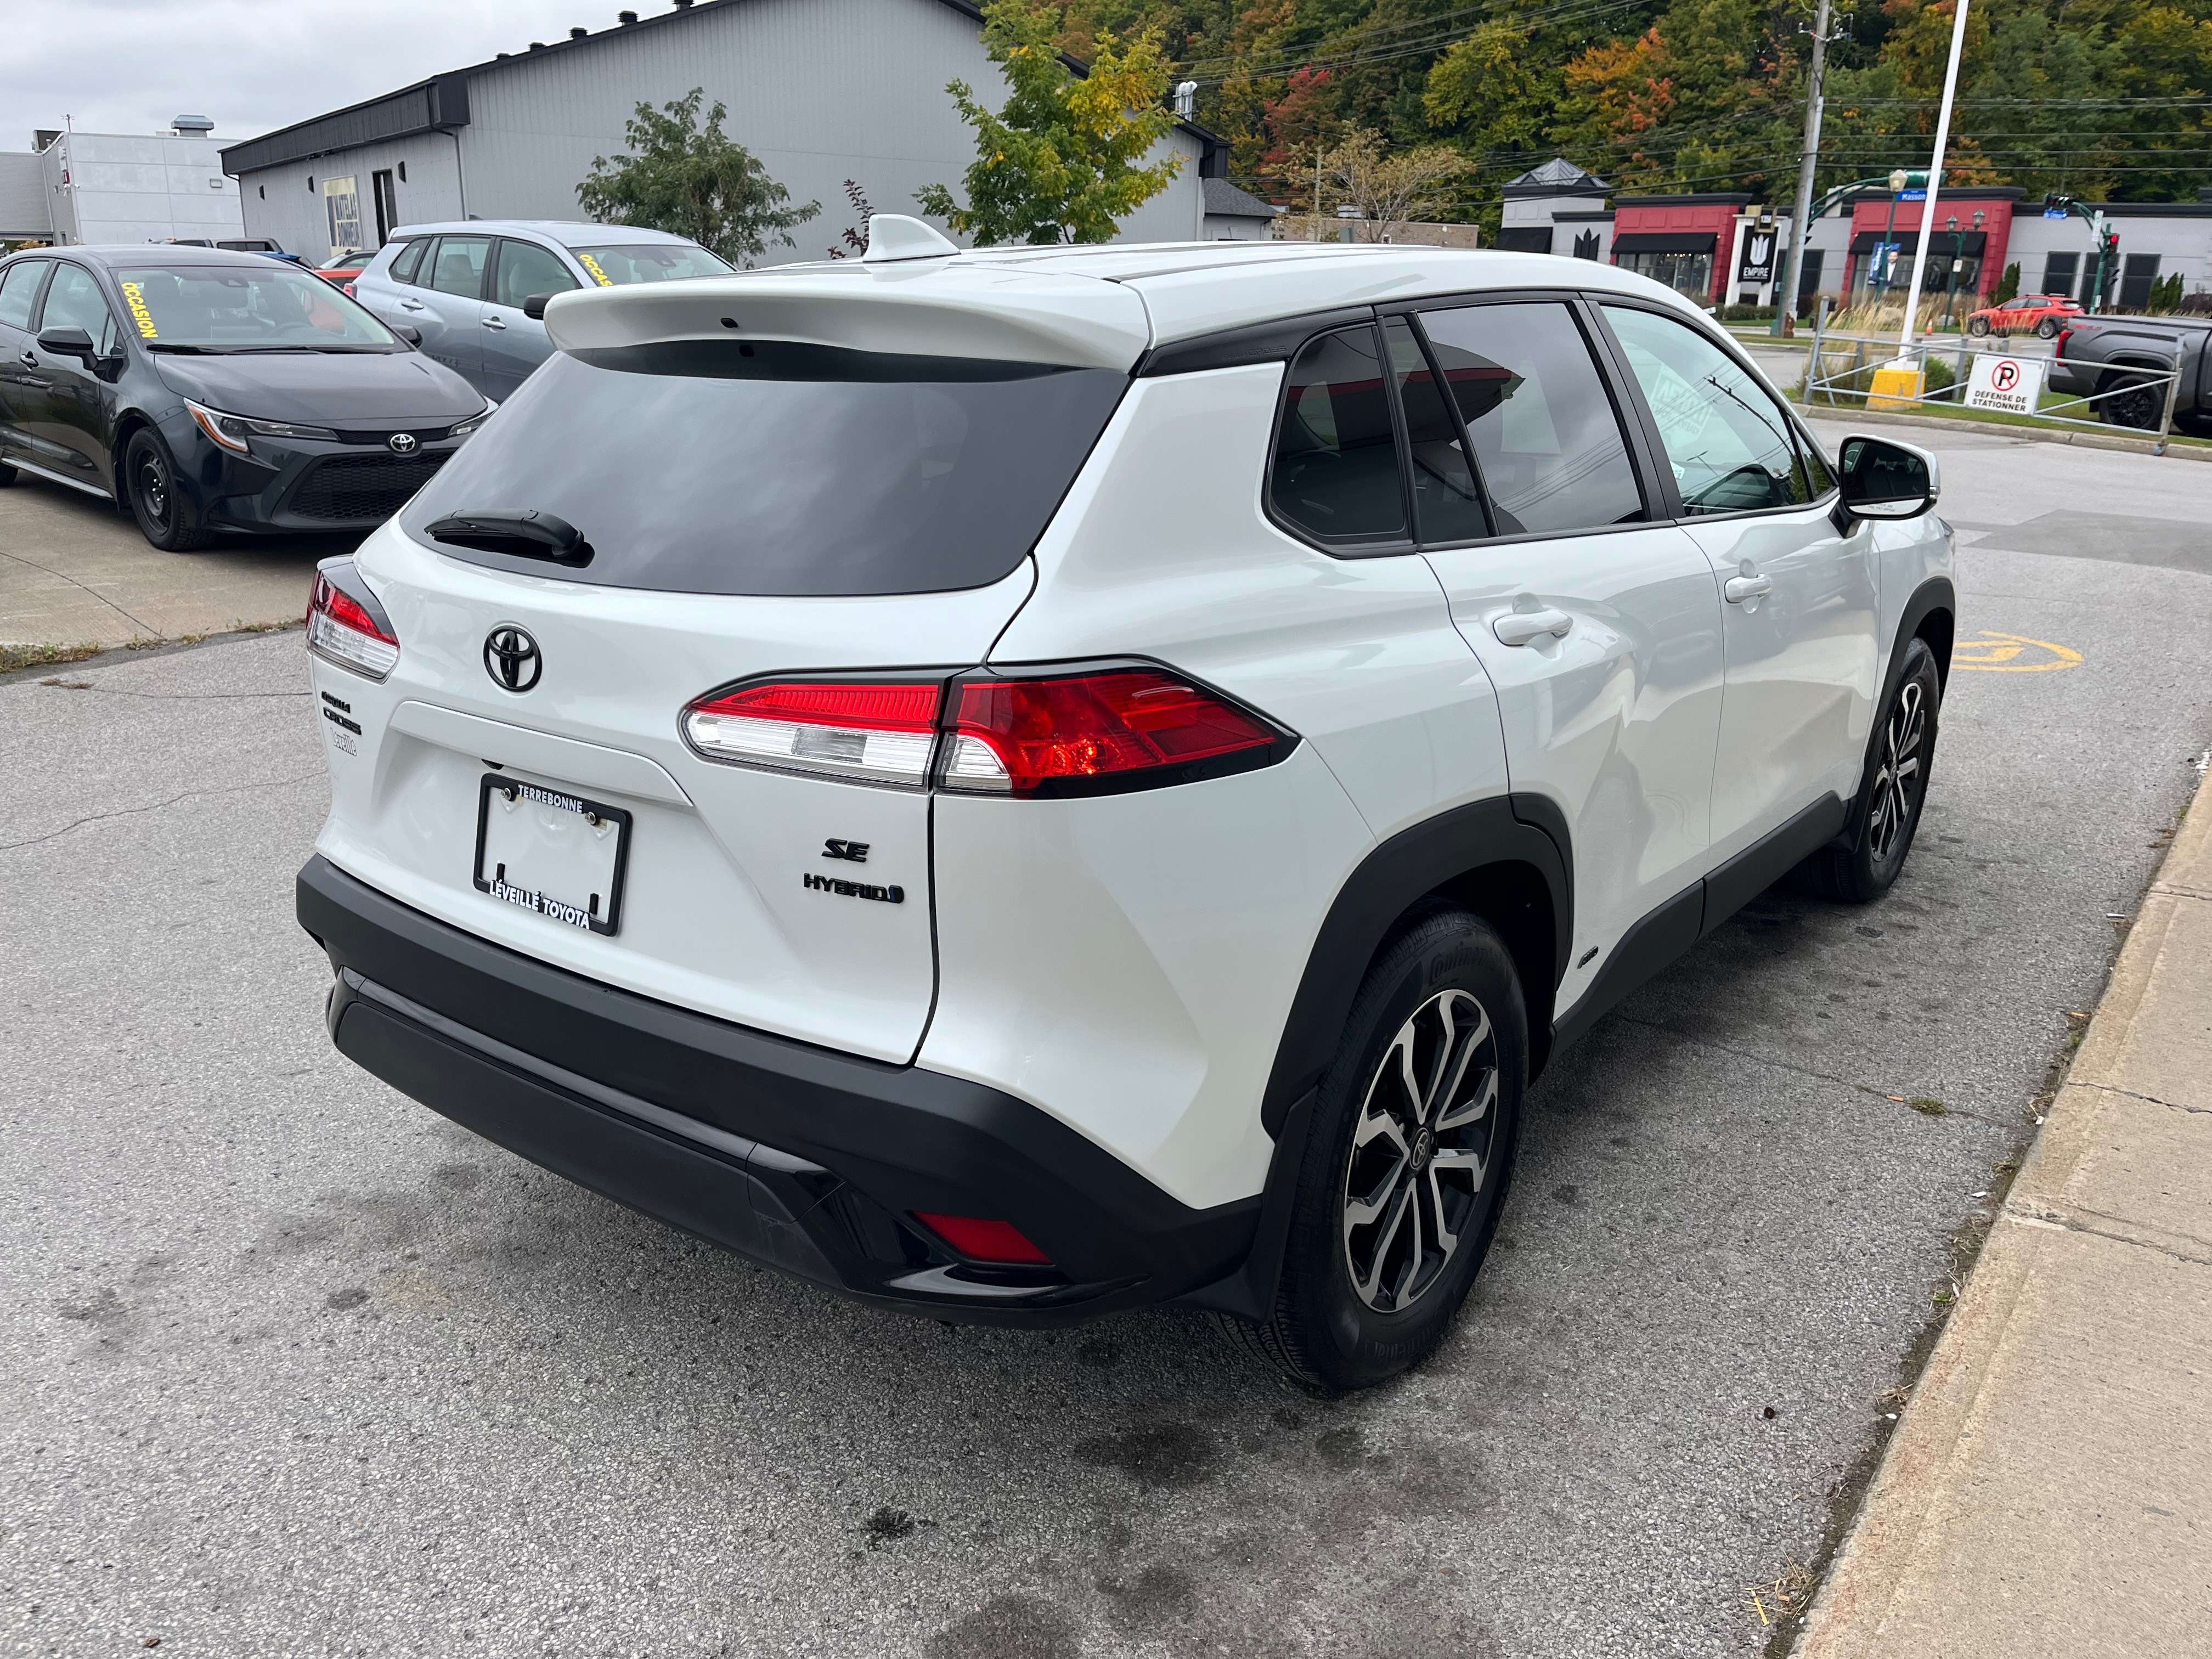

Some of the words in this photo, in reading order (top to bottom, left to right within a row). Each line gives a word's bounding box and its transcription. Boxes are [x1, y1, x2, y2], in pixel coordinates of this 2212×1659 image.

[1743, 267, 1769, 277] EMPIRE
[122, 282, 159, 338] OCCASION
[1972, 398, 2026, 412] STATIONNER
[323, 706, 362, 735] CROSS
[518, 784, 583, 813] TERREBONNE
[821, 838, 870, 863] SE
[803, 872, 889, 901] HYBRID
[489, 879, 541, 911] LÉVEILLÉ
[543, 898, 590, 930] TOYOTA
